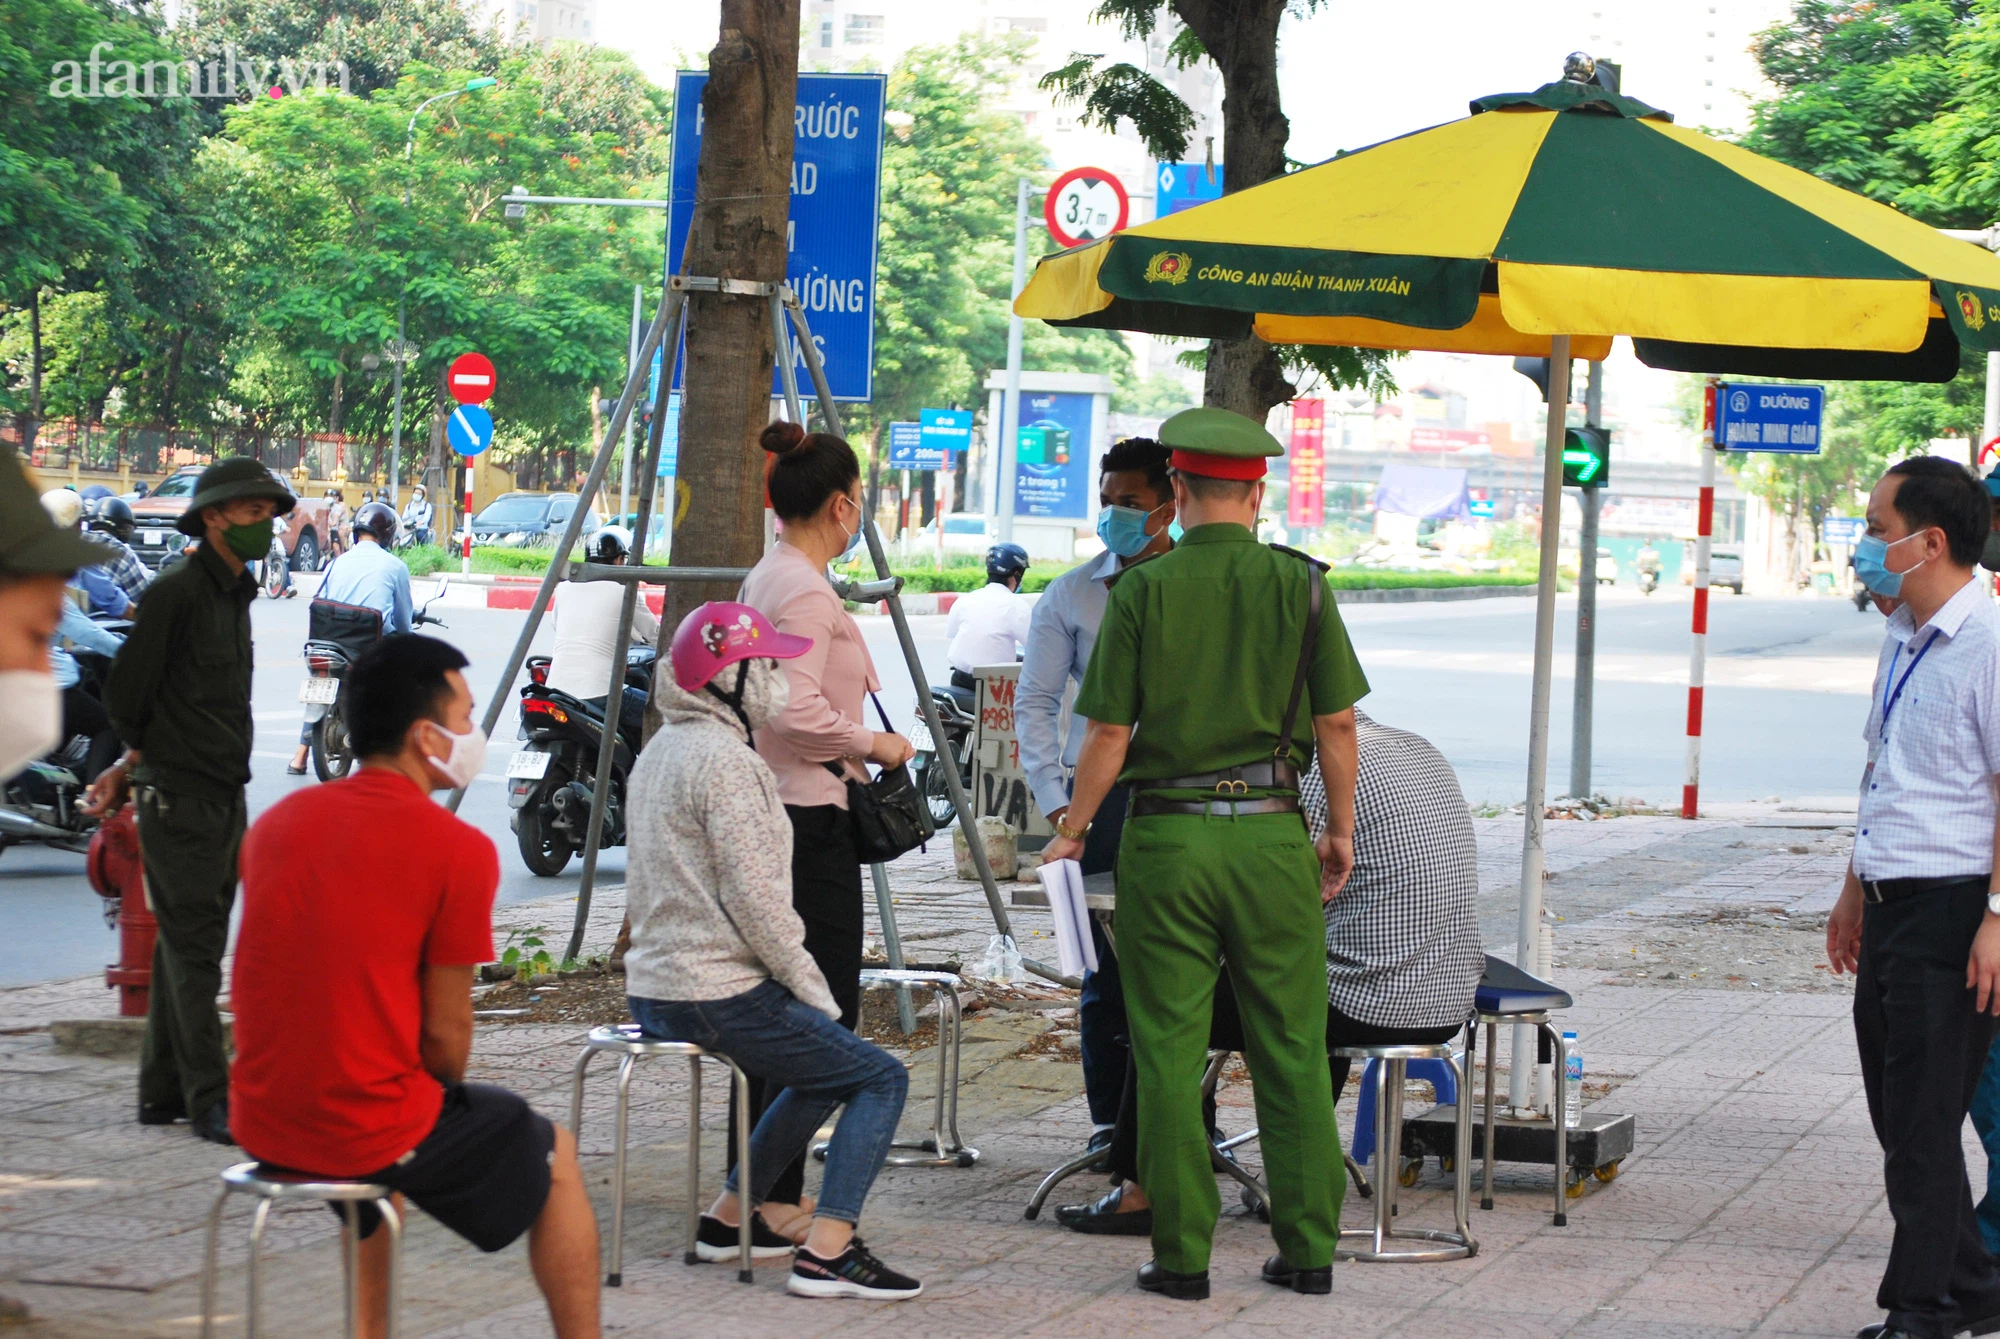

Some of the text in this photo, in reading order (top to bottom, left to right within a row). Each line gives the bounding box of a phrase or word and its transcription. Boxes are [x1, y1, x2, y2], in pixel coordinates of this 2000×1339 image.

[1197, 264, 1412, 296] CÔNG AN QUẬN THANH XUÂN
[1759, 393, 1810, 410] ĐƯỜNG
[1726, 419, 1818, 445] HOÀNG MINH GIÁM
[1018, 475, 1067, 490] 2 trong 1
